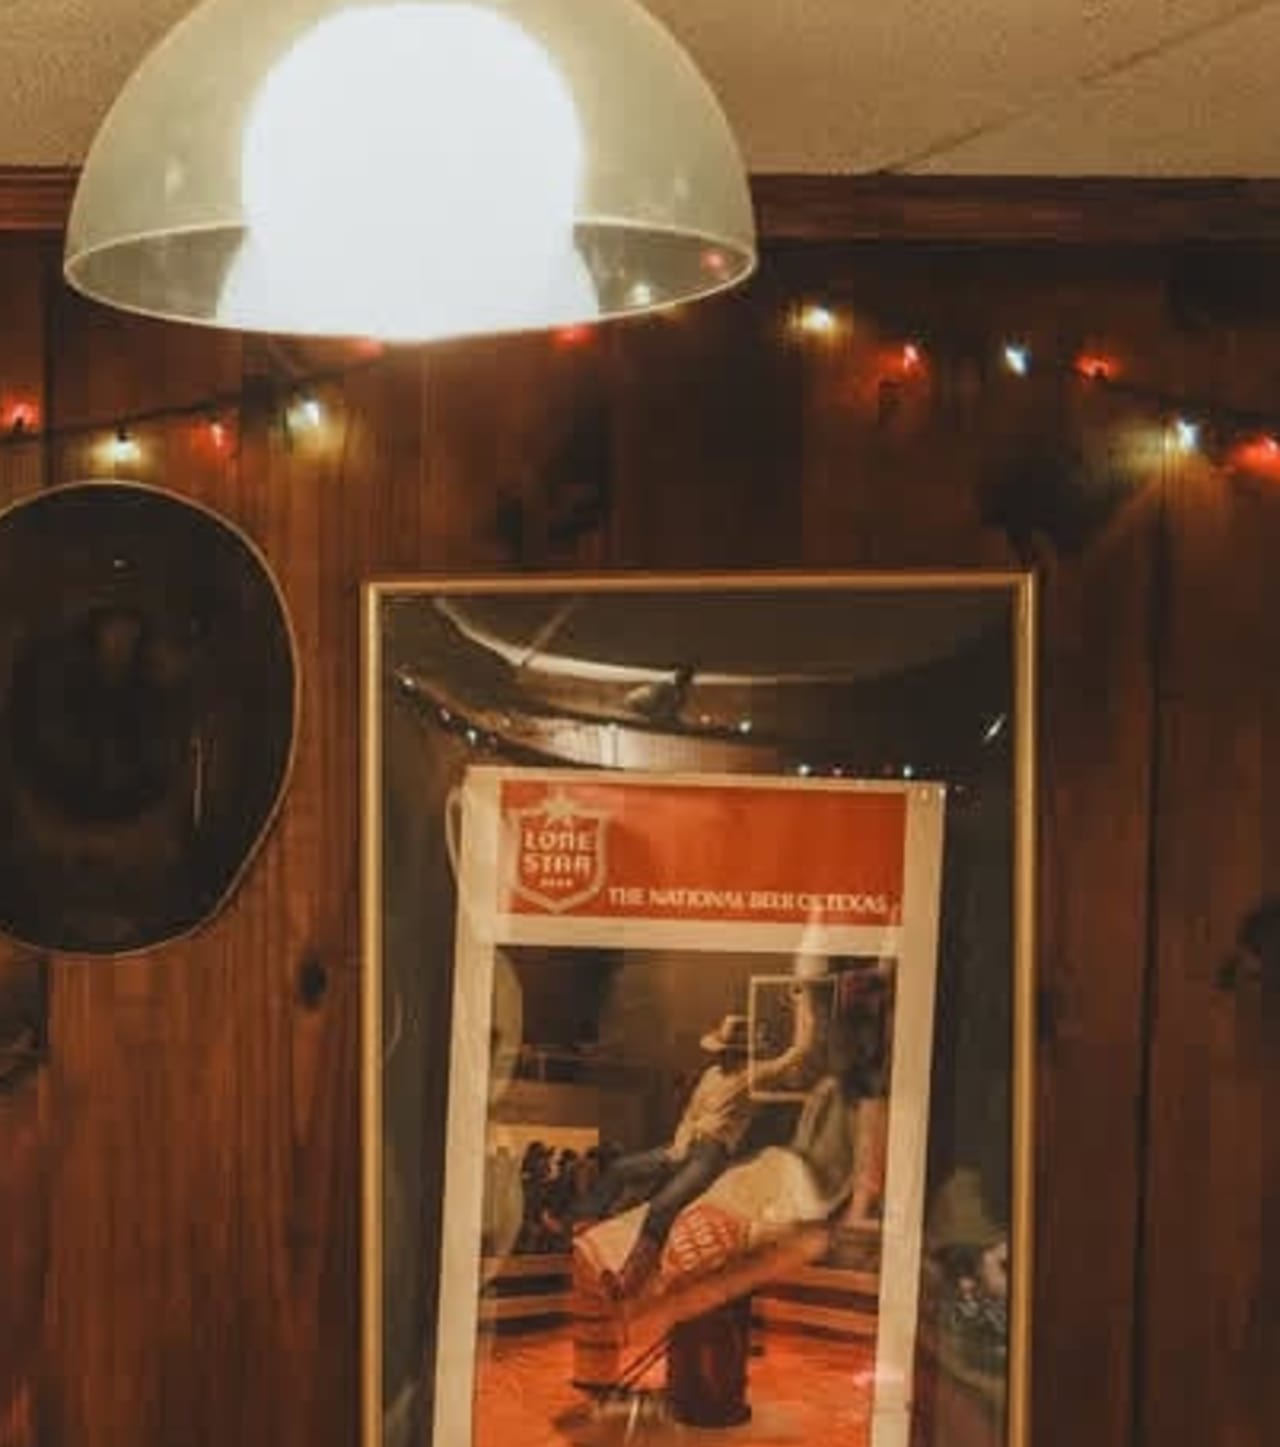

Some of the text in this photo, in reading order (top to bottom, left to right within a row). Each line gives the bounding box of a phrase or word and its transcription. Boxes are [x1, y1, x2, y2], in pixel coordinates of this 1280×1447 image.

[524, 830, 593, 851] LONE
[523, 852, 592, 877] STAR
[608, 887, 645, 905] THE
